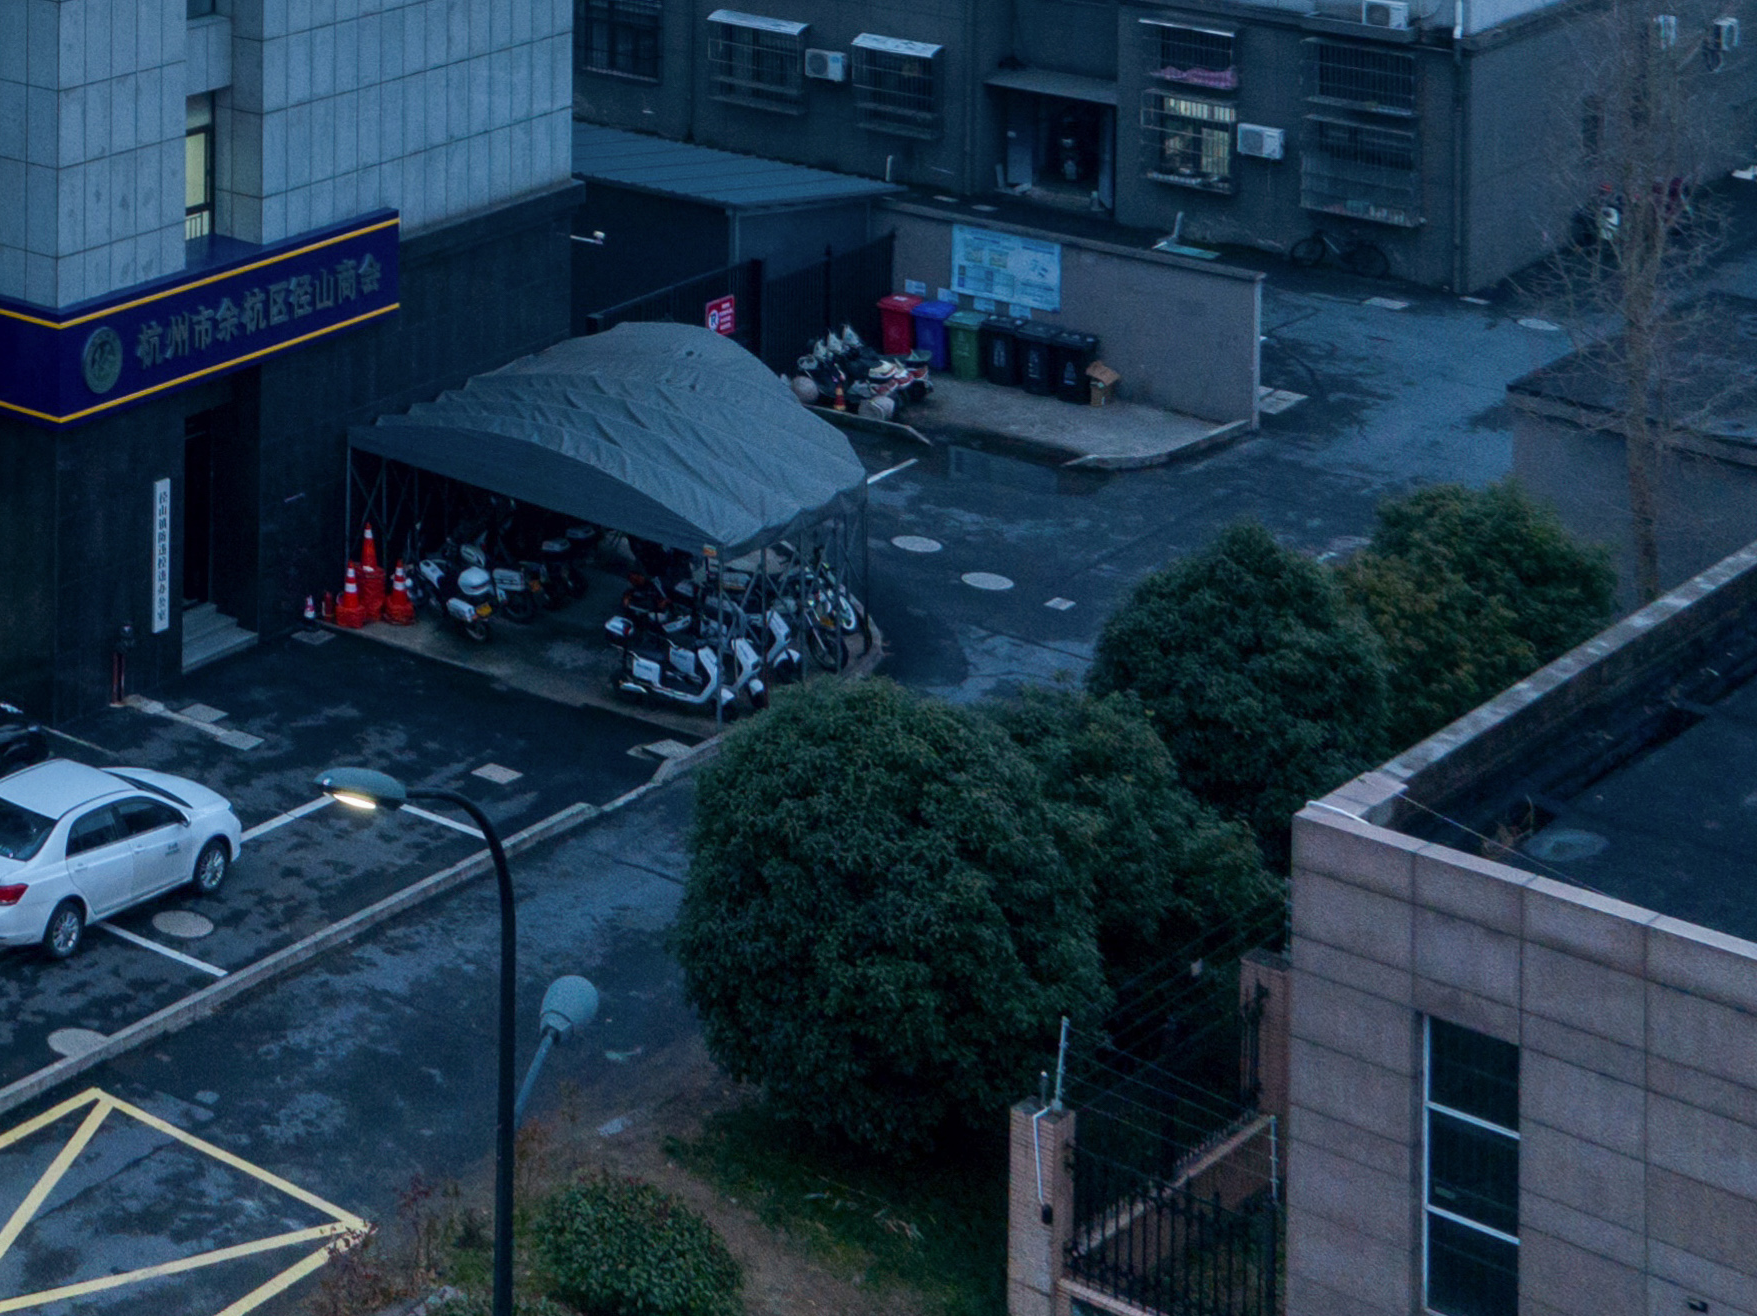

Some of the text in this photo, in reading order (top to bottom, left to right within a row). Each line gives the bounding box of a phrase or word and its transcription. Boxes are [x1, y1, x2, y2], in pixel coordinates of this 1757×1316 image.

[136, 254, 382, 369] 杭州市余杭区径山商会
